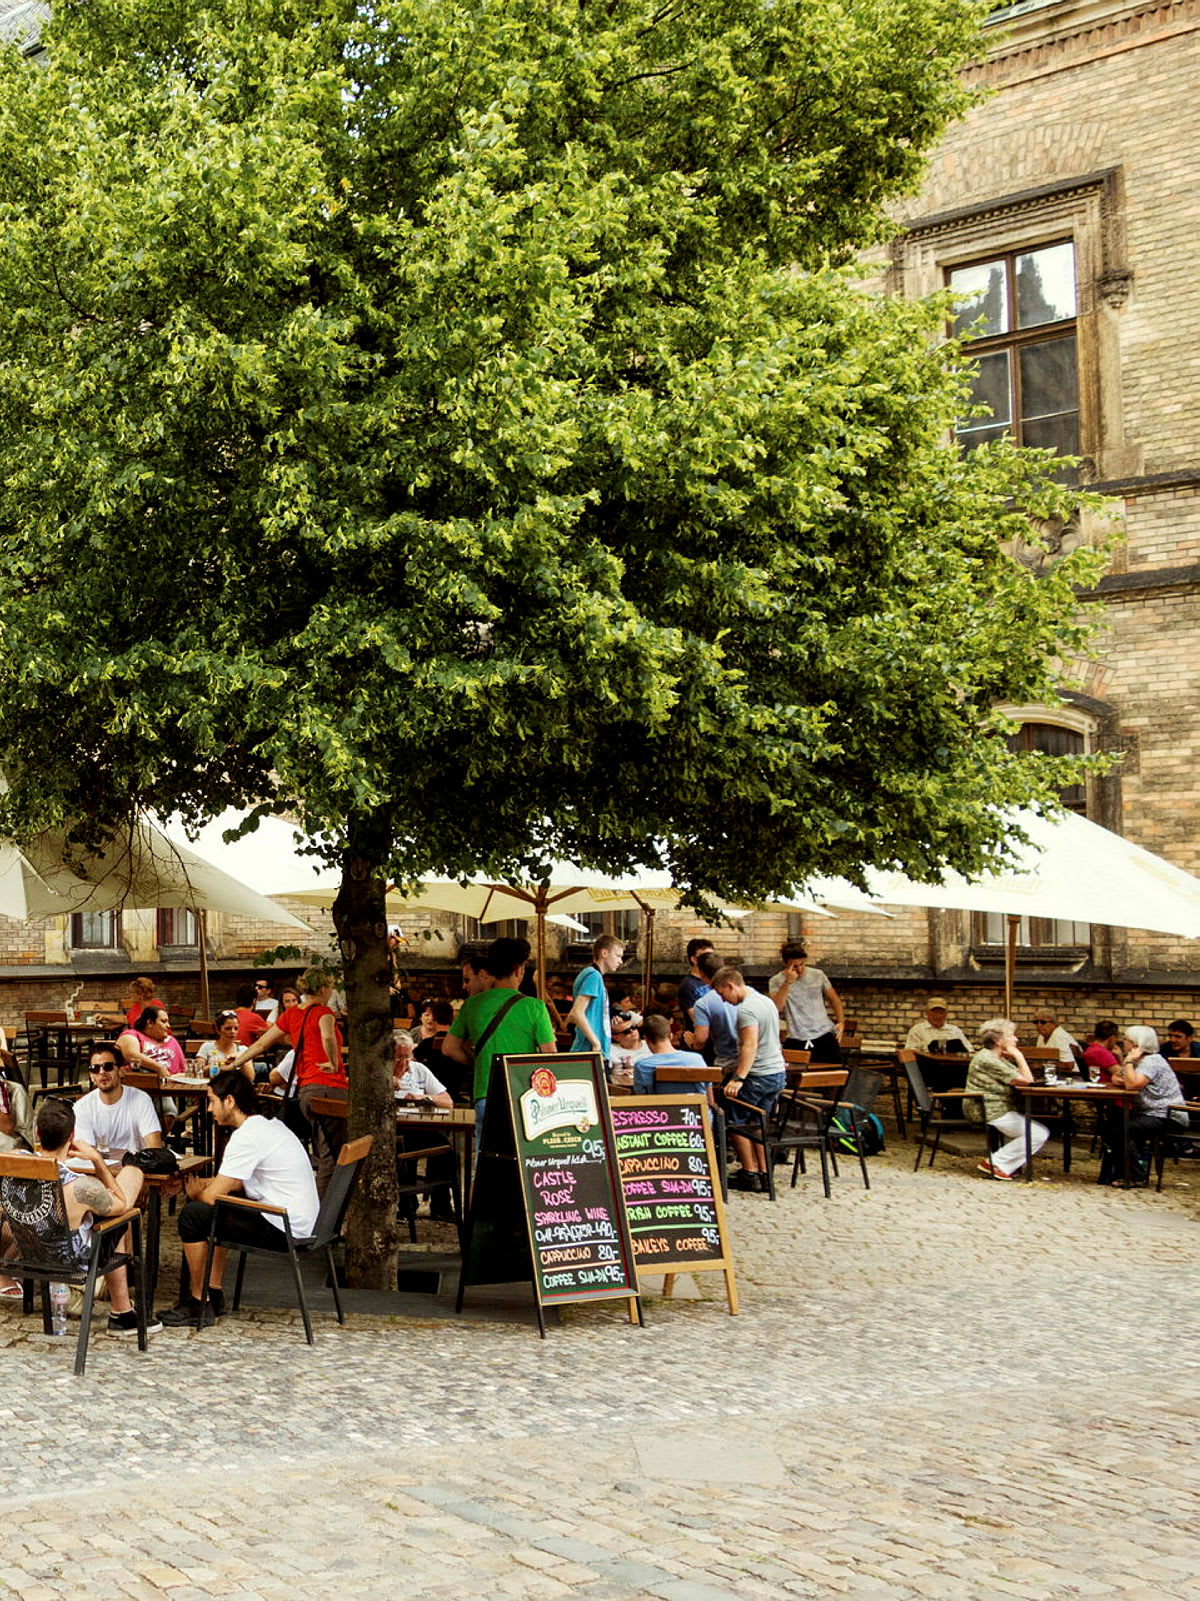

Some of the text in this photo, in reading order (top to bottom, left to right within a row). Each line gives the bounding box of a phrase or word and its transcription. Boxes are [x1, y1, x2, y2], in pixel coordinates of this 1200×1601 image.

[612, 1110, 668, 1126] ESPRESSO
[654, 1132, 689, 1147] COFFEE
[619, 1156, 680, 1174] CAPPUCCINO
[533, 1170, 577, 1188] CASTLE
[534, 1207, 609, 1227] SPARKLING WINE
[655, 1204, 693, 1219] COFFEE
[631, 1237, 709, 1255] BAILEYS COFFEE
[540, 1246, 592, 1265] CAPPUCCINO
[543, 1273, 576, 1288] COFFEE
